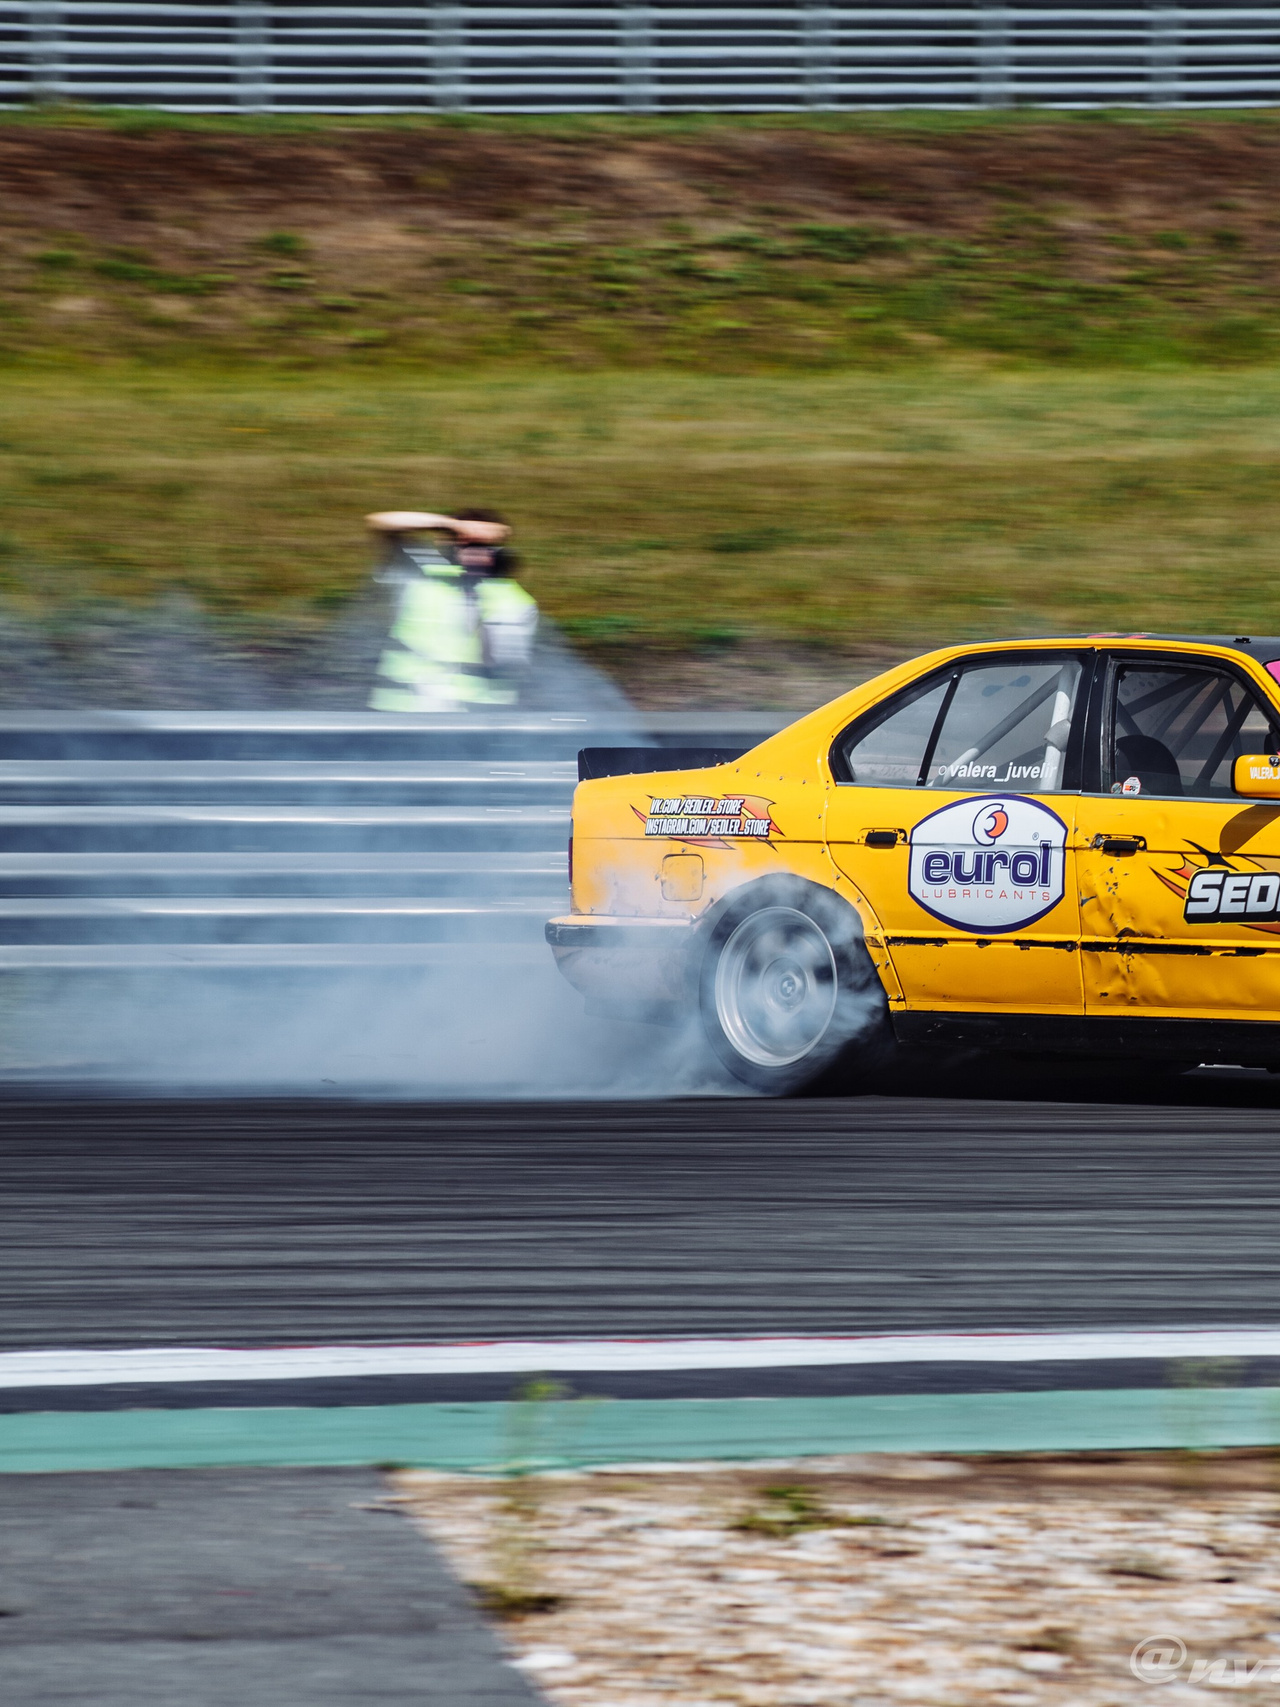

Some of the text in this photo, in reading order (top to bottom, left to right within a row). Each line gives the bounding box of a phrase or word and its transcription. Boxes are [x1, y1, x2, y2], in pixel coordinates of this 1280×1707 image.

[950, 761, 1057, 782] valera_juvelir
[650, 798, 744, 816] VK.COM/SEDLER_STORE
[645, 818, 771, 836] INSTAGRAM.COM/SEDLER_STORE
[922, 840, 1052, 887] eurol
[922, 889, 1050, 901] LUBRICANTS
